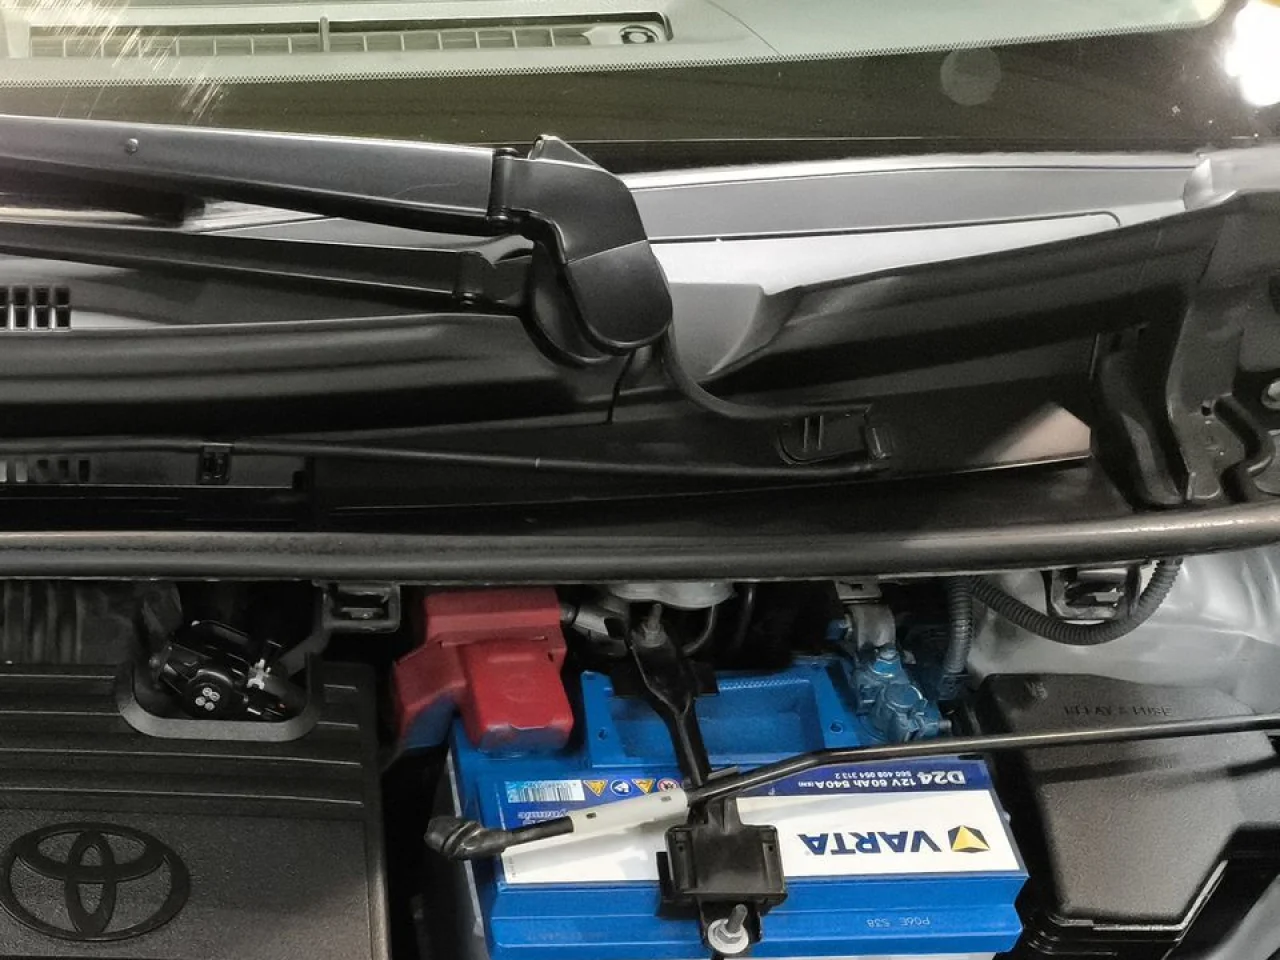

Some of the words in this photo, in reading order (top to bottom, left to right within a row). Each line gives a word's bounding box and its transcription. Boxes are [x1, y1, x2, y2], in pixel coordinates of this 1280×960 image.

[891, 778, 916, 788] 12V
[916, 770, 967, 786] D24
[797, 830, 942, 856] VARTA
